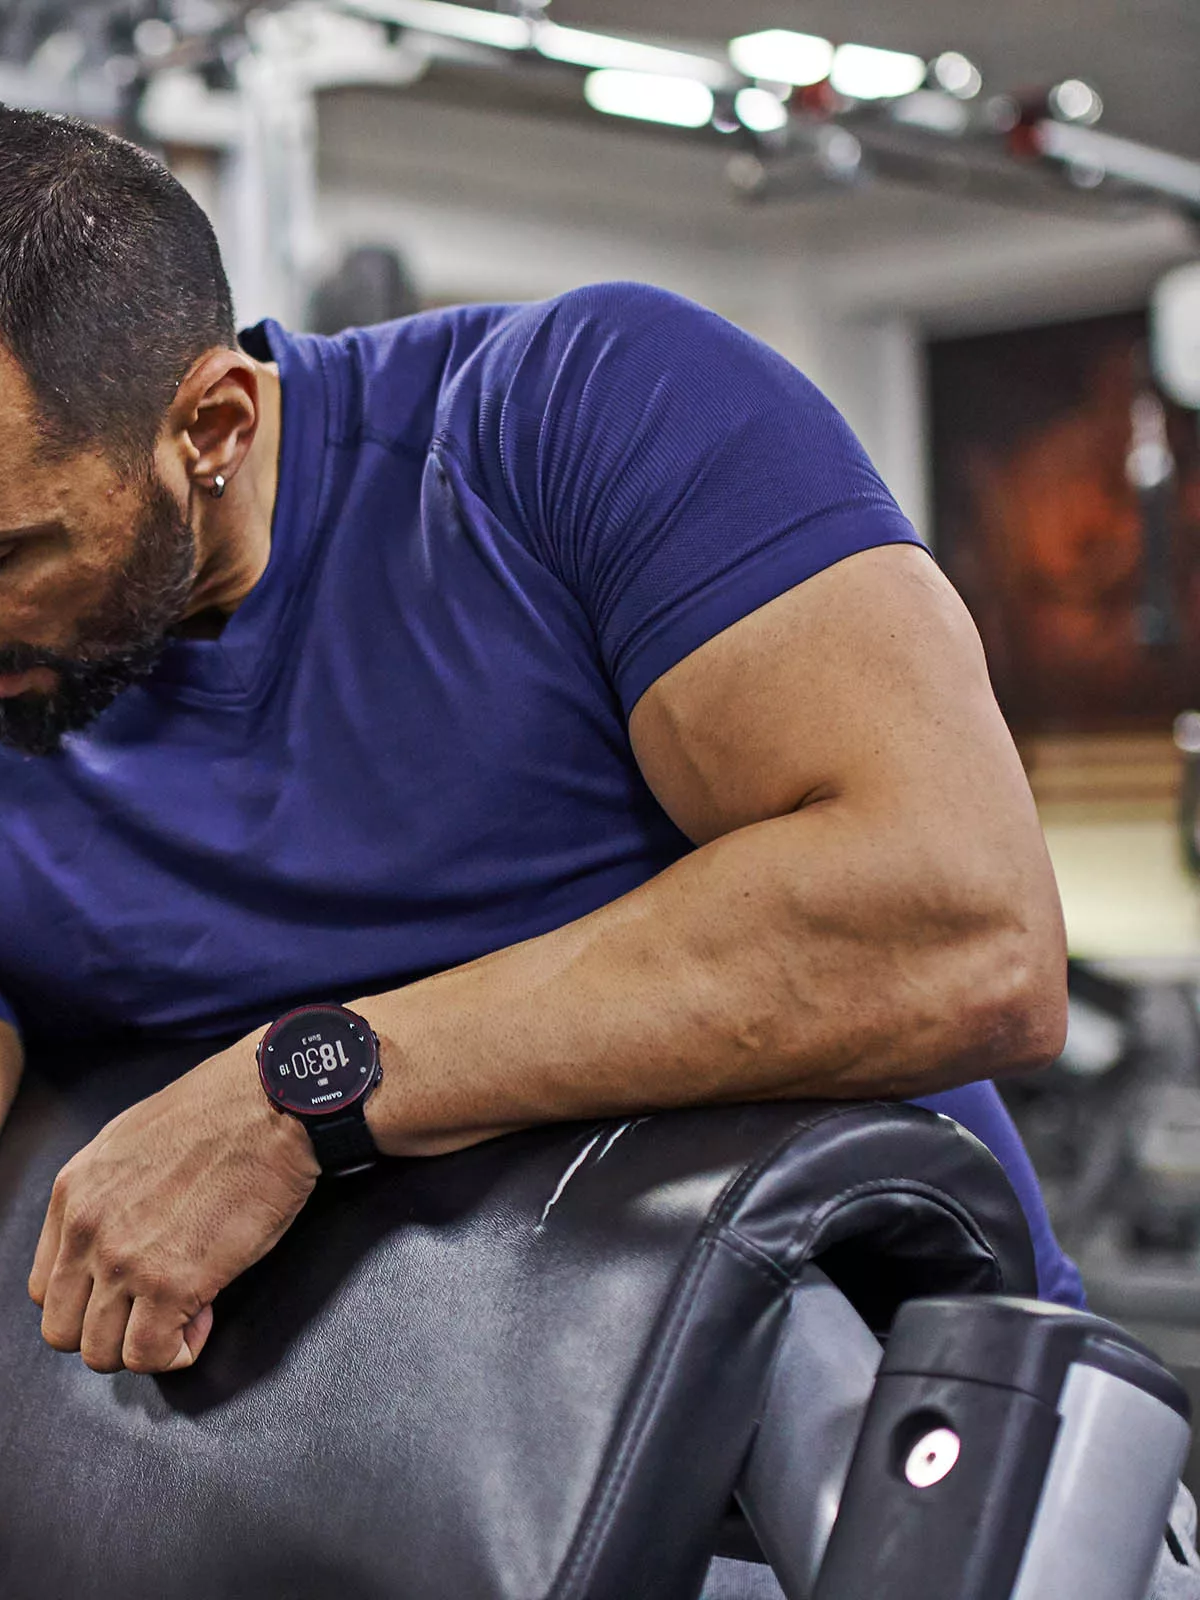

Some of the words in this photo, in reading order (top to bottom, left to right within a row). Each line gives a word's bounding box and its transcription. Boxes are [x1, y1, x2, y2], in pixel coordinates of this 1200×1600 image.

[308, 1033, 321, 1042] Sun
[279, 1063, 291, 1076] 19
[311, 1090, 343, 1104] GARMIN
